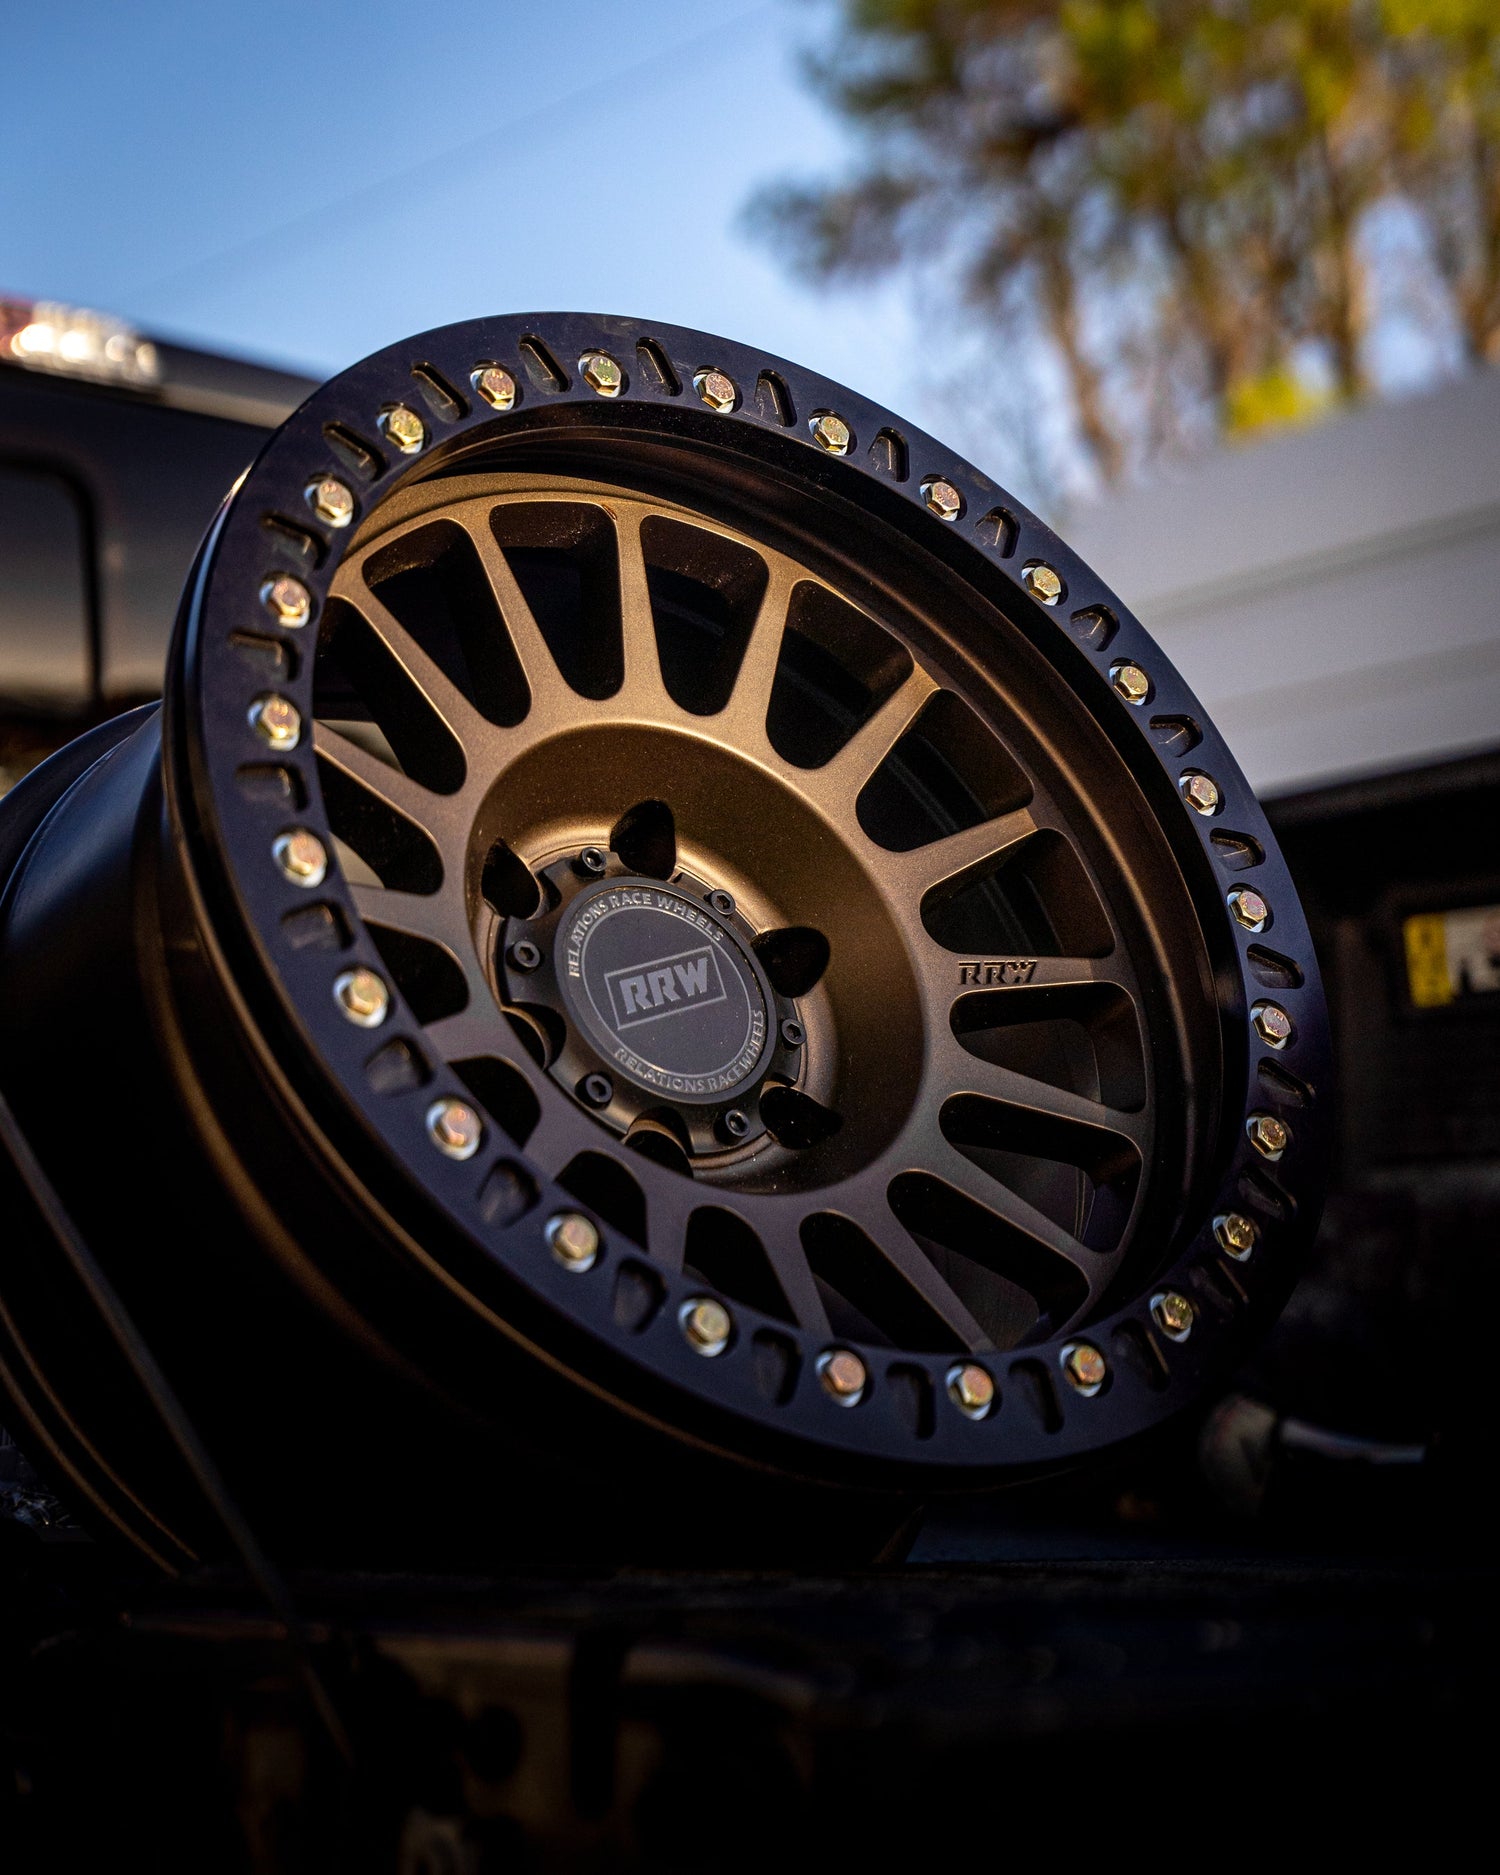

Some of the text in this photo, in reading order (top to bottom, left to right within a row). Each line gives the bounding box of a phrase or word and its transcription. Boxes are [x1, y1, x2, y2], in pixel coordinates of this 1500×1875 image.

[567, 892, 724, 978] RELATIONS RACE WHEELS
[619, 957, 708, 1015] RRW
[958, 960, 1038, 985] RRW
[614, 1048, 705, 1092] RELATIONS
